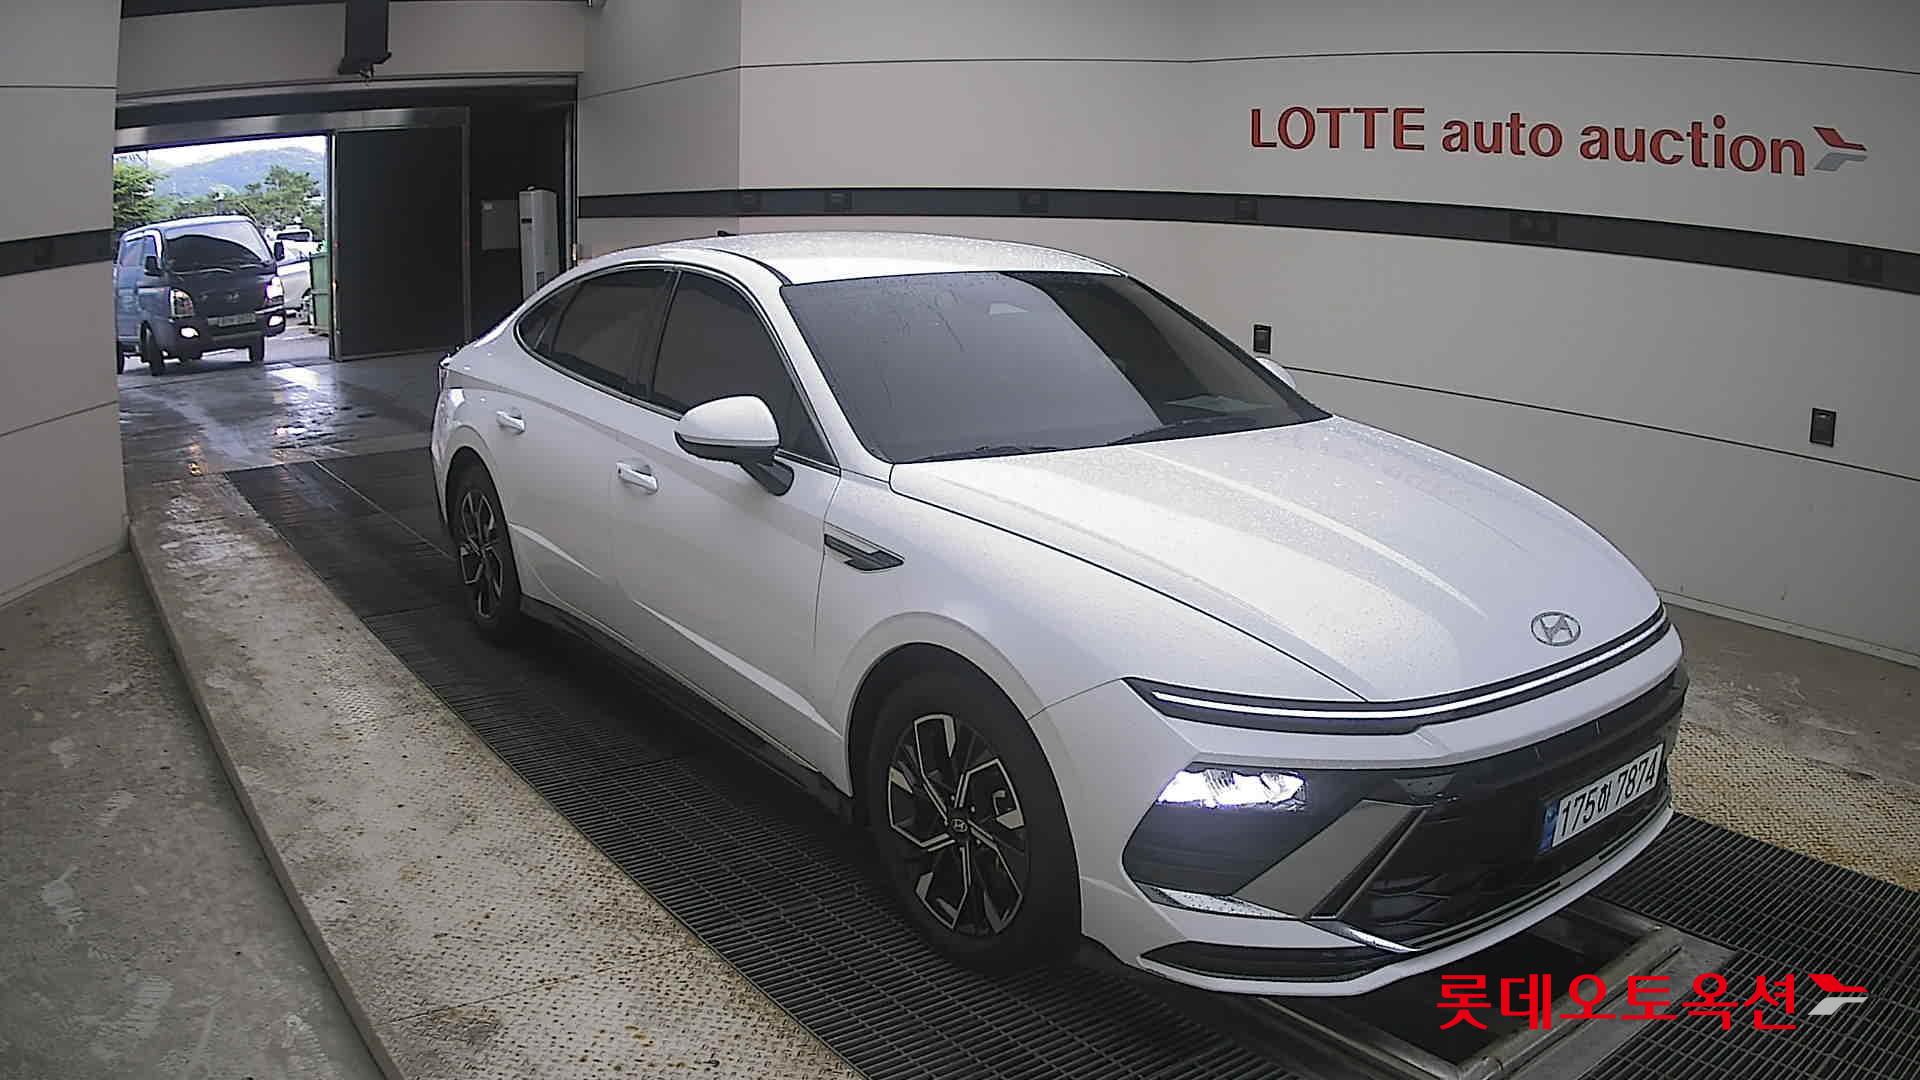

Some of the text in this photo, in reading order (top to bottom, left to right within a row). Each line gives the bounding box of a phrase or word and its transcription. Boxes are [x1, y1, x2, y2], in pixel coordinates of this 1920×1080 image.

[1250, 107, 1806, 176] LOTTE auto auction
[1615, 751, 1659, 806] 7874
